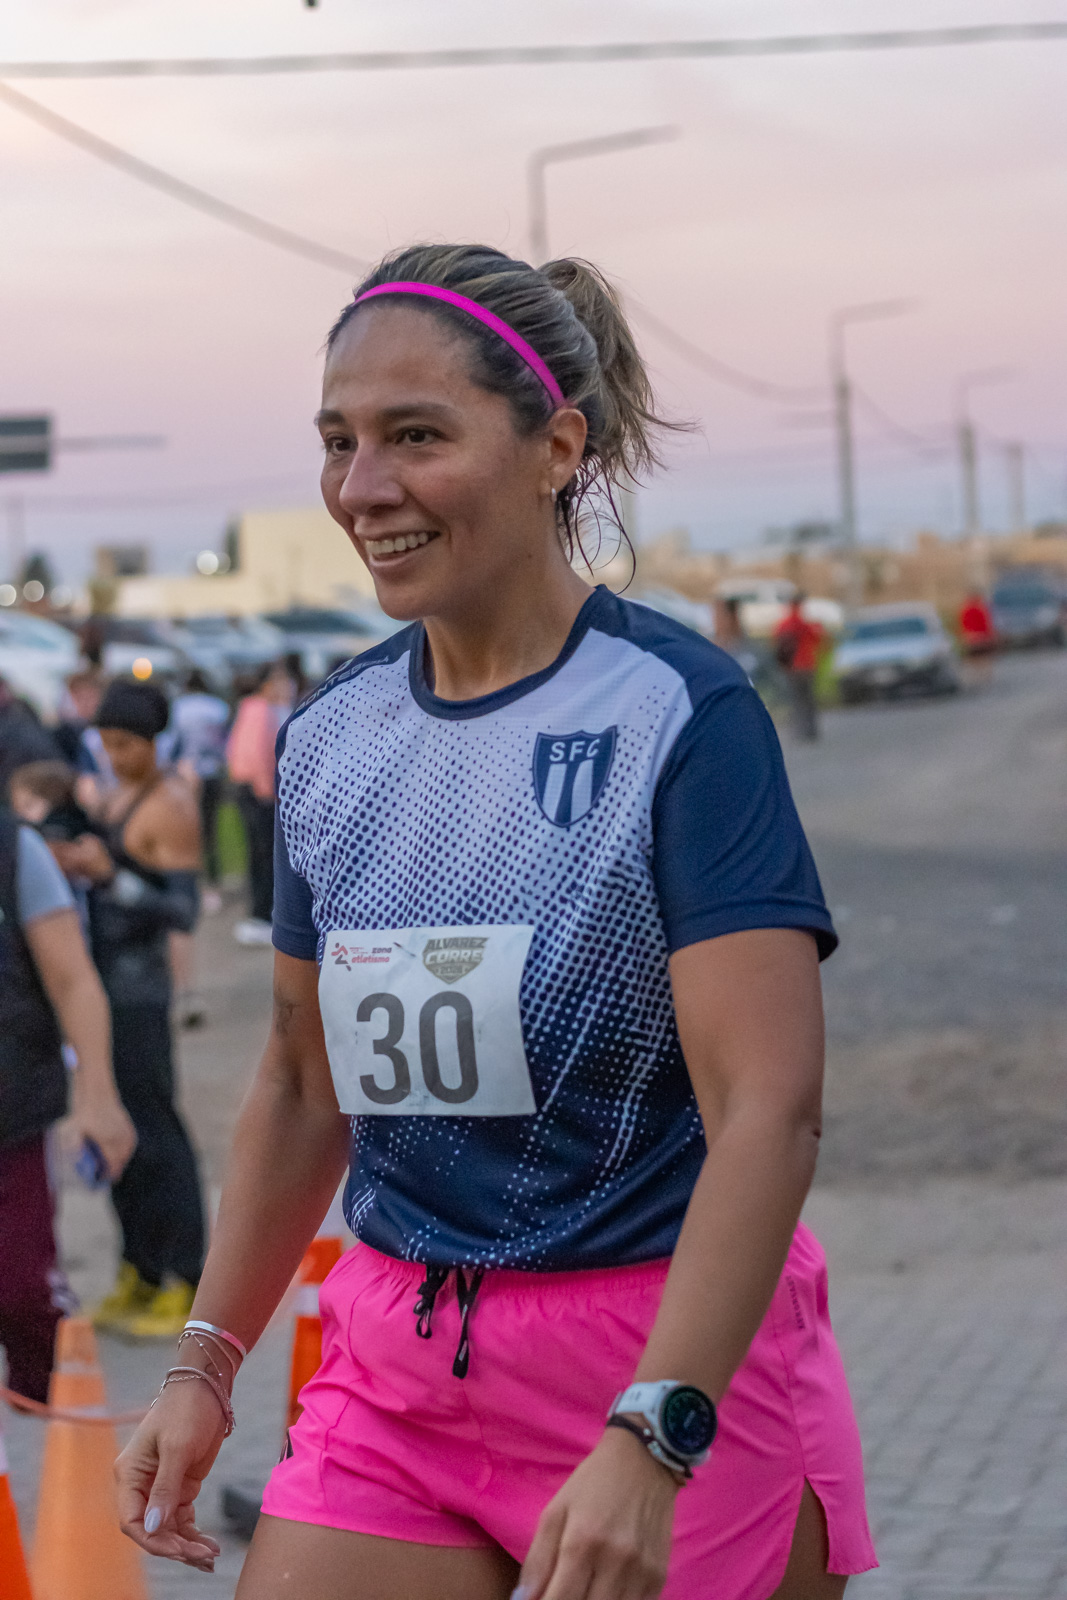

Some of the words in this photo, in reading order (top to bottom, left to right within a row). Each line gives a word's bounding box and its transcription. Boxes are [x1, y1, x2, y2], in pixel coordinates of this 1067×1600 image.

[549, 738, 600, 762] SFC
[425, 937, 489, 950] ALVAREZ
[351, 954, 390, 964] atletismo
[425, 949, 484, 966] CORRE
[356, 990, 479, 1105] 30
